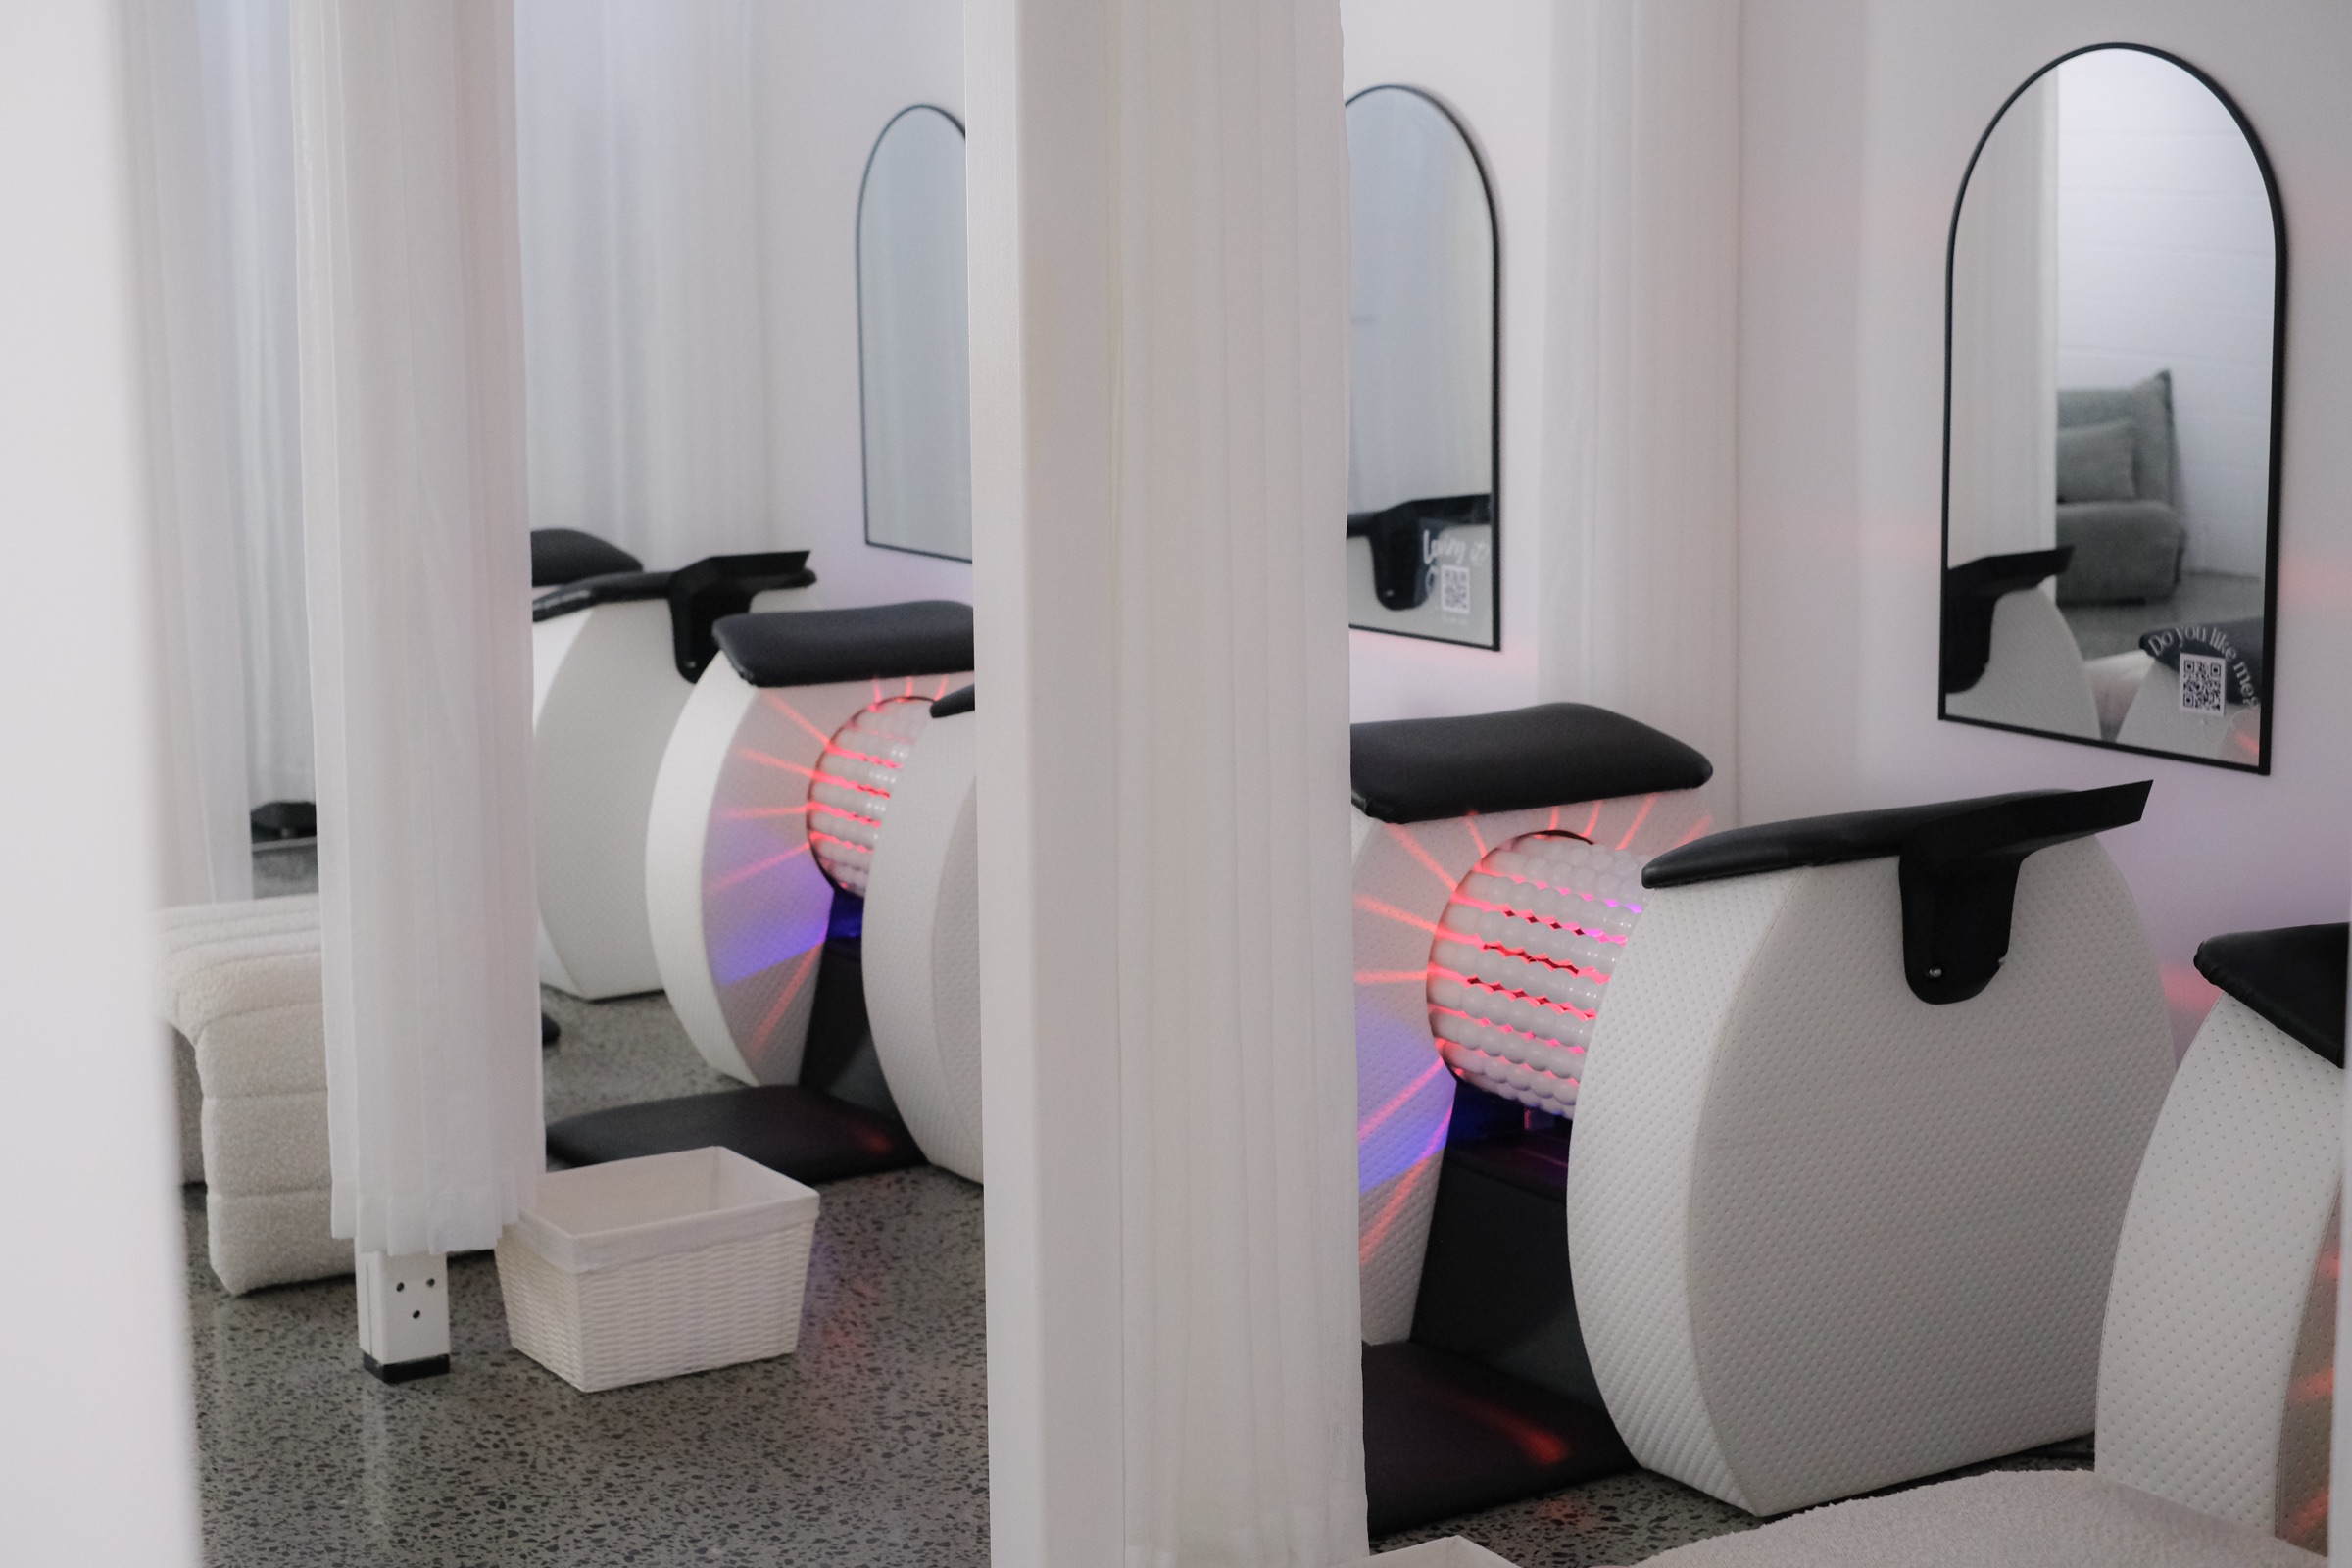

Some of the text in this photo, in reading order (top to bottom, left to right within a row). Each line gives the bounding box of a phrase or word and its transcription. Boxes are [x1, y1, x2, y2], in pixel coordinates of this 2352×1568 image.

[2148, 631, 2174, 656] Do
[2175, 625, 2207, 649] you
[2209, 626, 2238, 662] like
